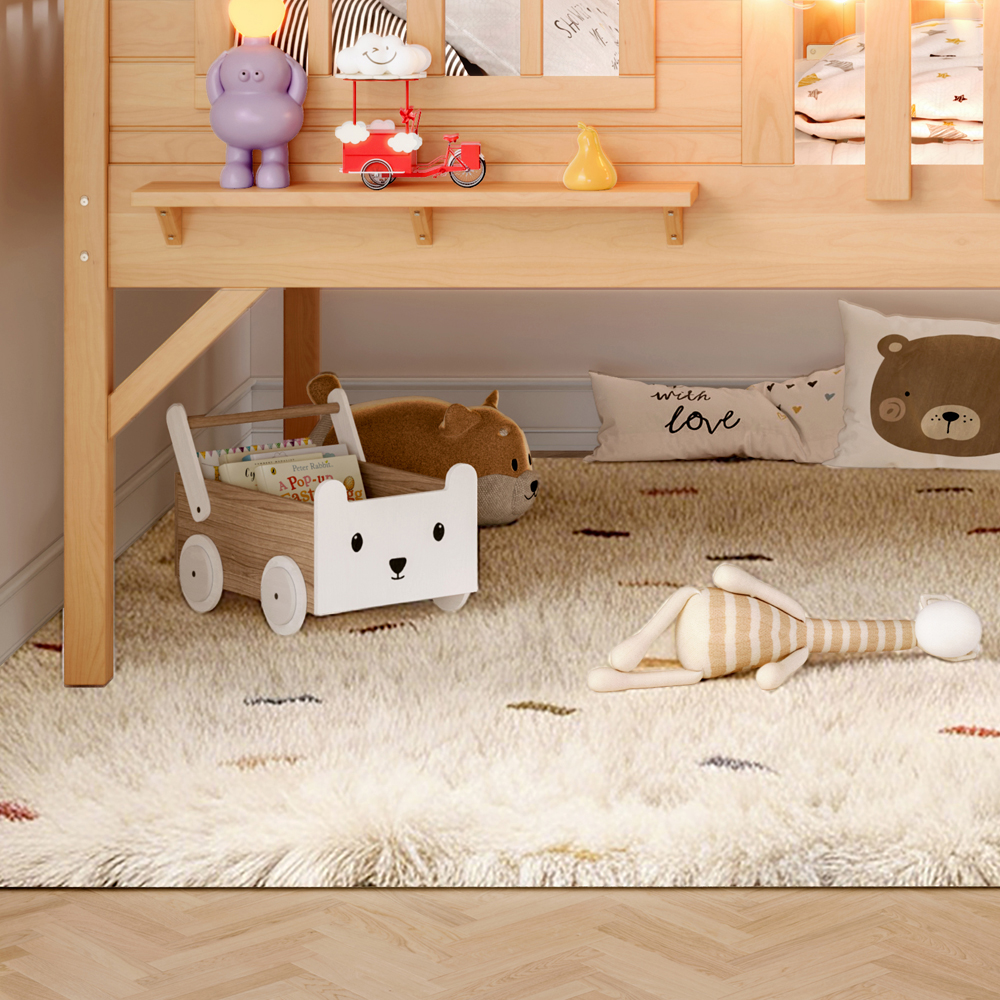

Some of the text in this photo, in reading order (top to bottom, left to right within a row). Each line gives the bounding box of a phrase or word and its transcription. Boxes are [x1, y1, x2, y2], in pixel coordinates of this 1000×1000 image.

[665, 405, 741, 434] love
[293, 464, 309, 472] Peter
[279, 481, 288, 491] A
